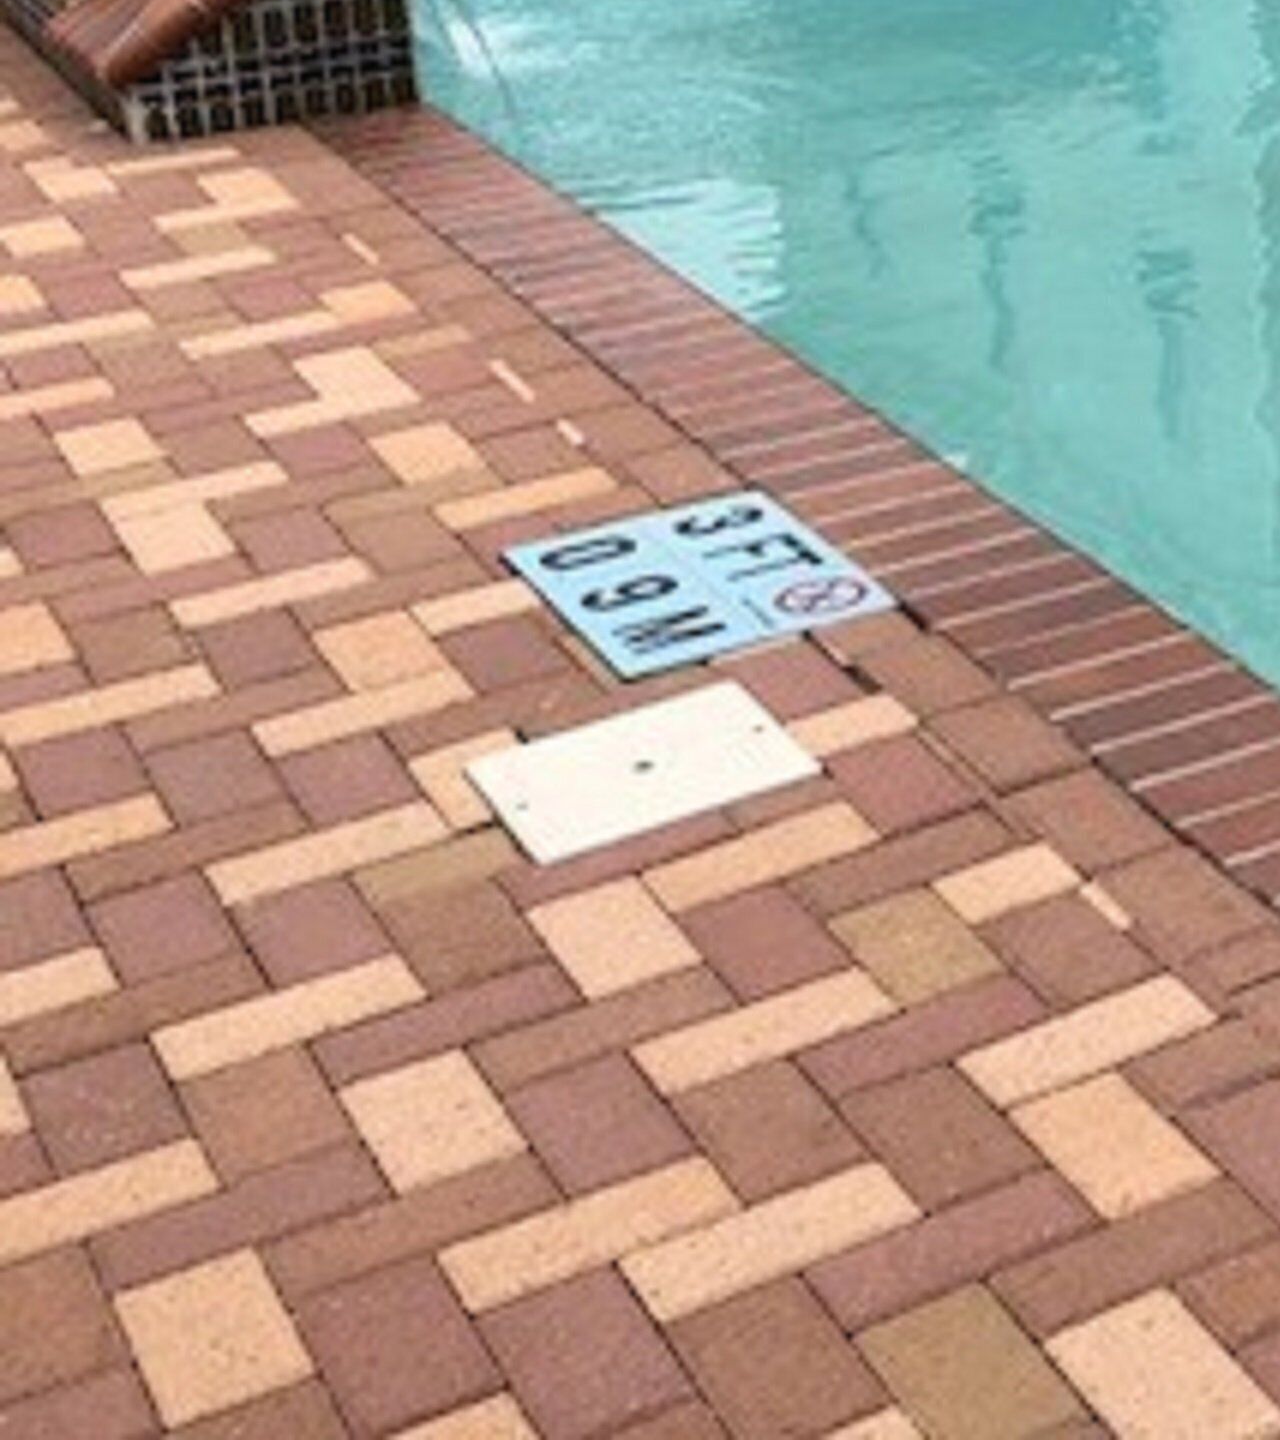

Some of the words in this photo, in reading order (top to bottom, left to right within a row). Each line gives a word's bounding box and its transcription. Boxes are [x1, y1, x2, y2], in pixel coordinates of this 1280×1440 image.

[673, 503, 764, 538] 3
[538, 534, 638, 572] 0
[701, 532, 824, 582] FT
[580, 574, 680, 613] 9
[611, 605, 728, 655] M
